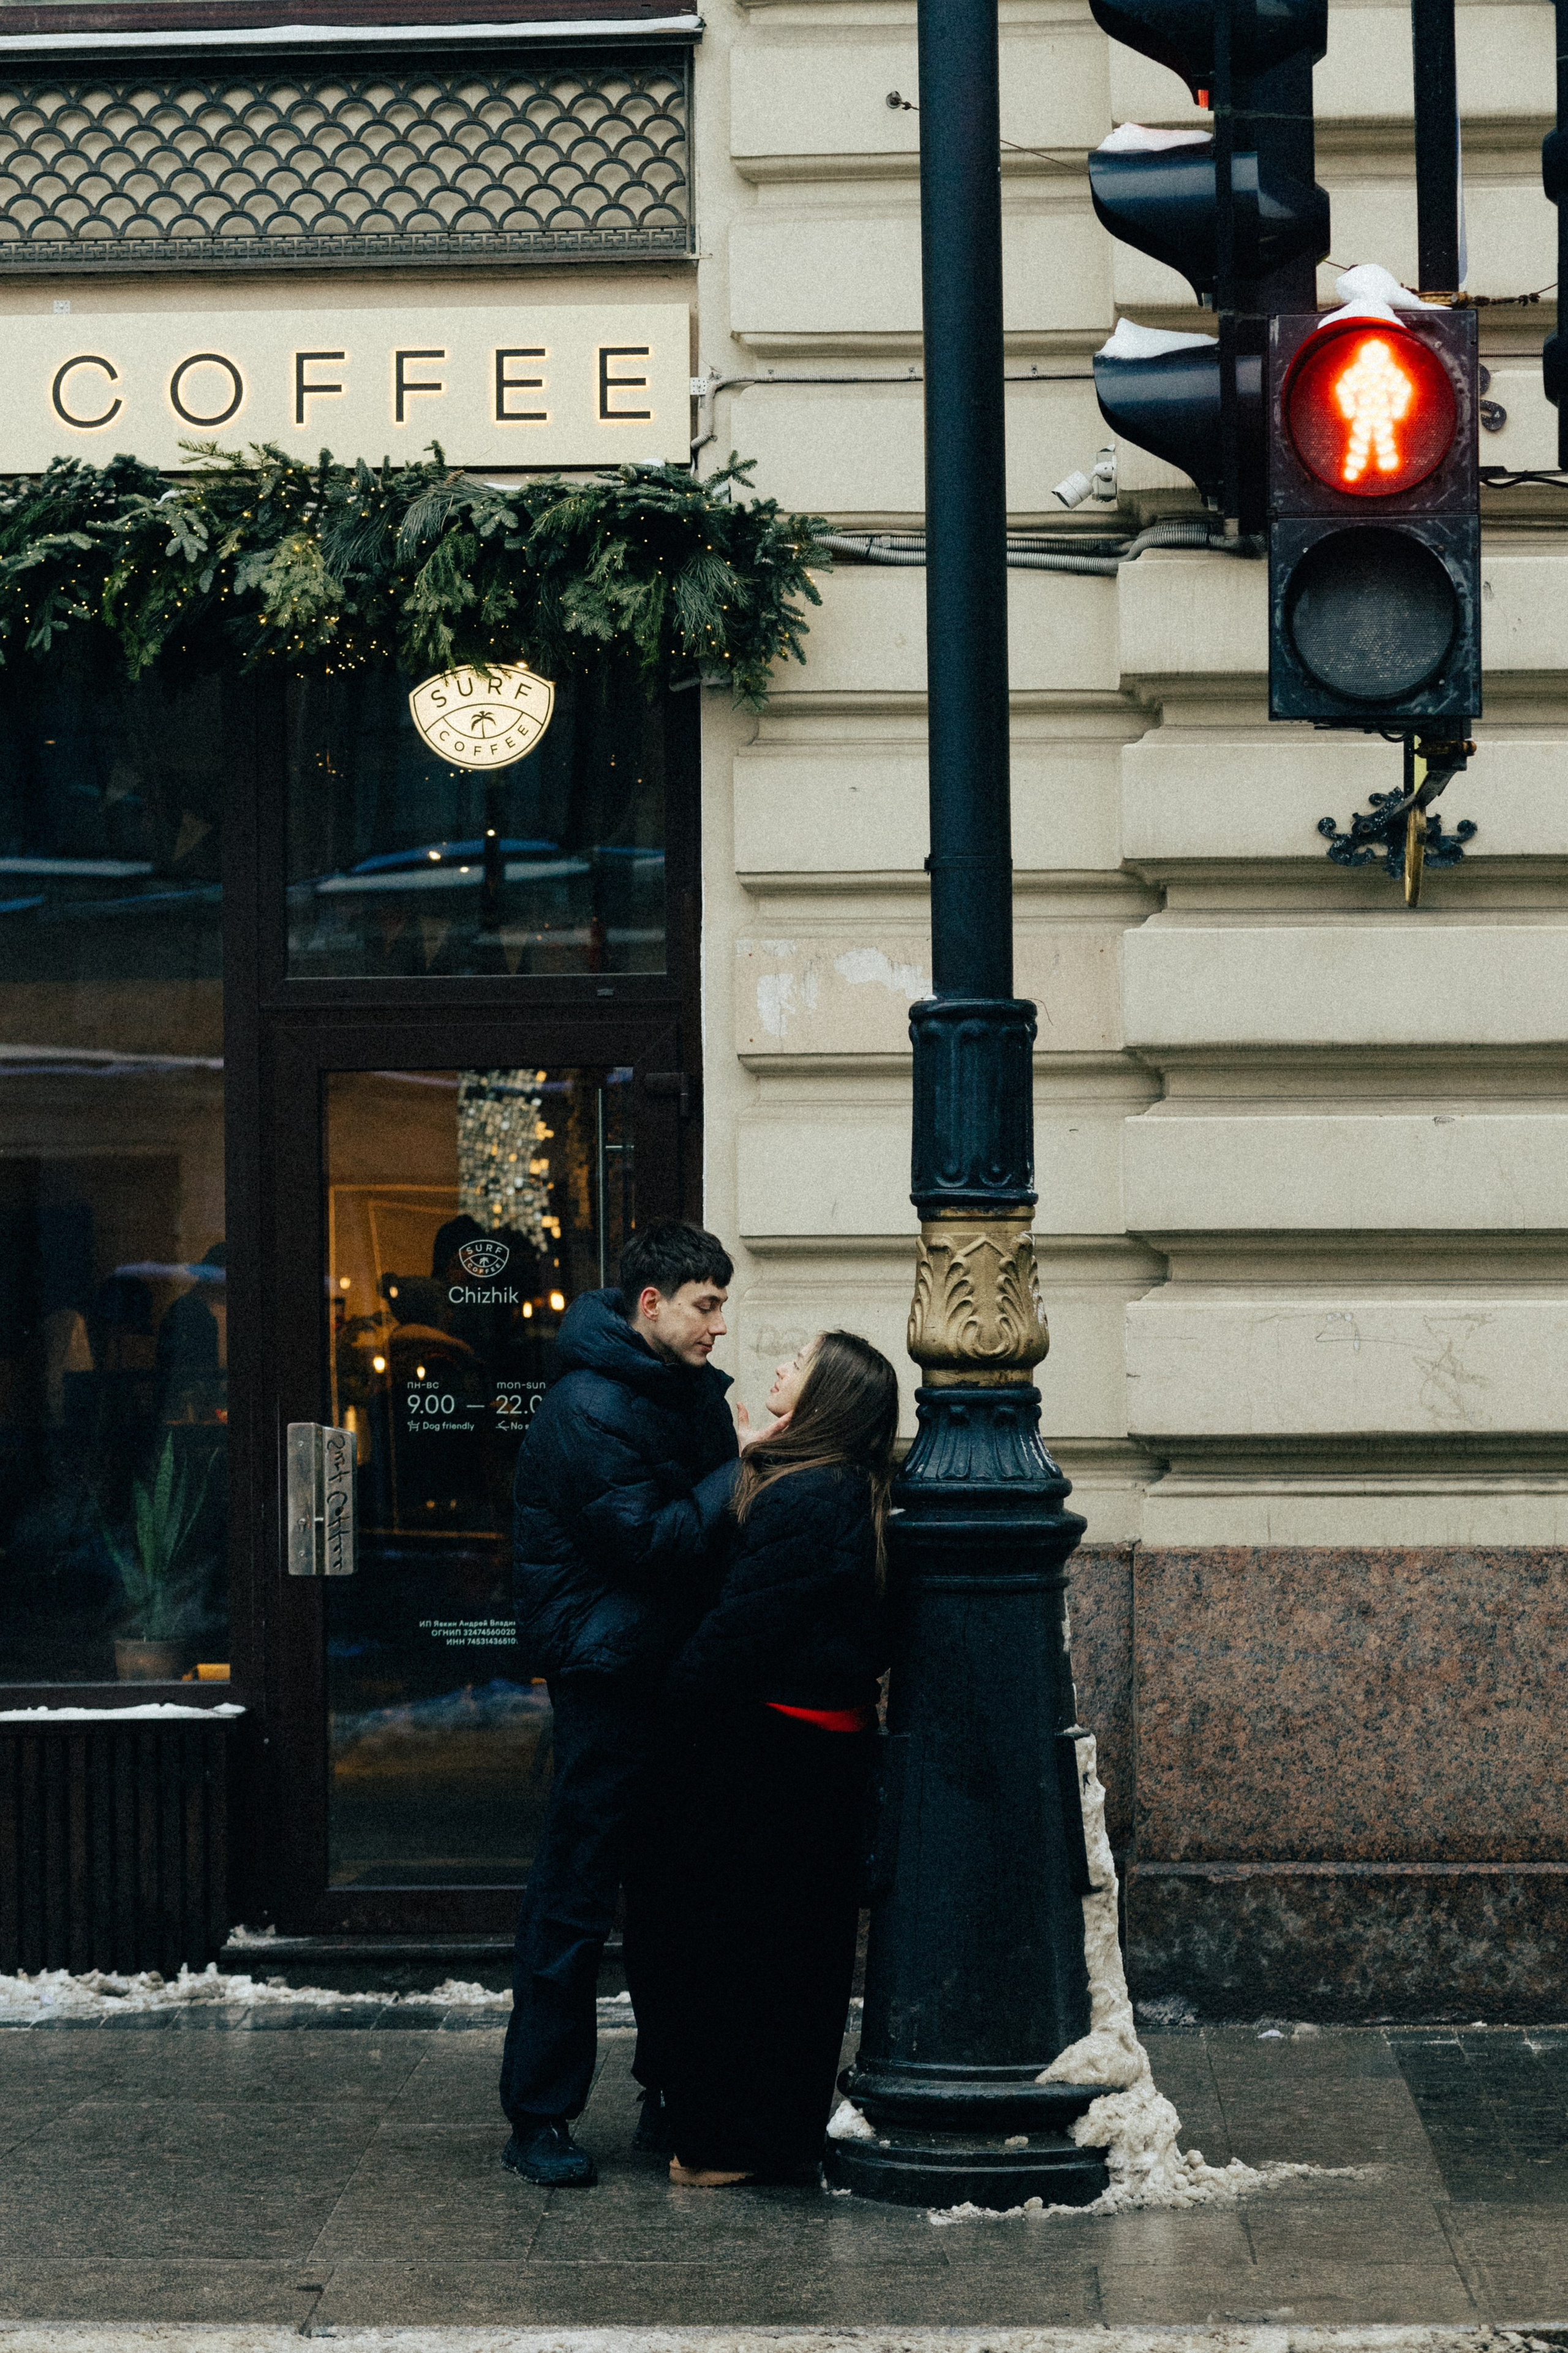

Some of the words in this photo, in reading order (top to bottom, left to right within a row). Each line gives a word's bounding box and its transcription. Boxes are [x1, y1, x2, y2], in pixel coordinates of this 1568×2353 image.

[53, 347, 650, 427] COFFEE
[430, 676, 532, 708] SURF
[439, 724, 529, 757] COFFEE
[466, 1244, 503, 1255] SURF
[467, 1263, 502, 1275] COFFEE
[449, 1286, 518, 1303] Chizhik
[408, 1395, 454, 1413] 9.00
[423, 1422, 440, 1431] Dog
[442, 1422, 474, 1430] friendly
